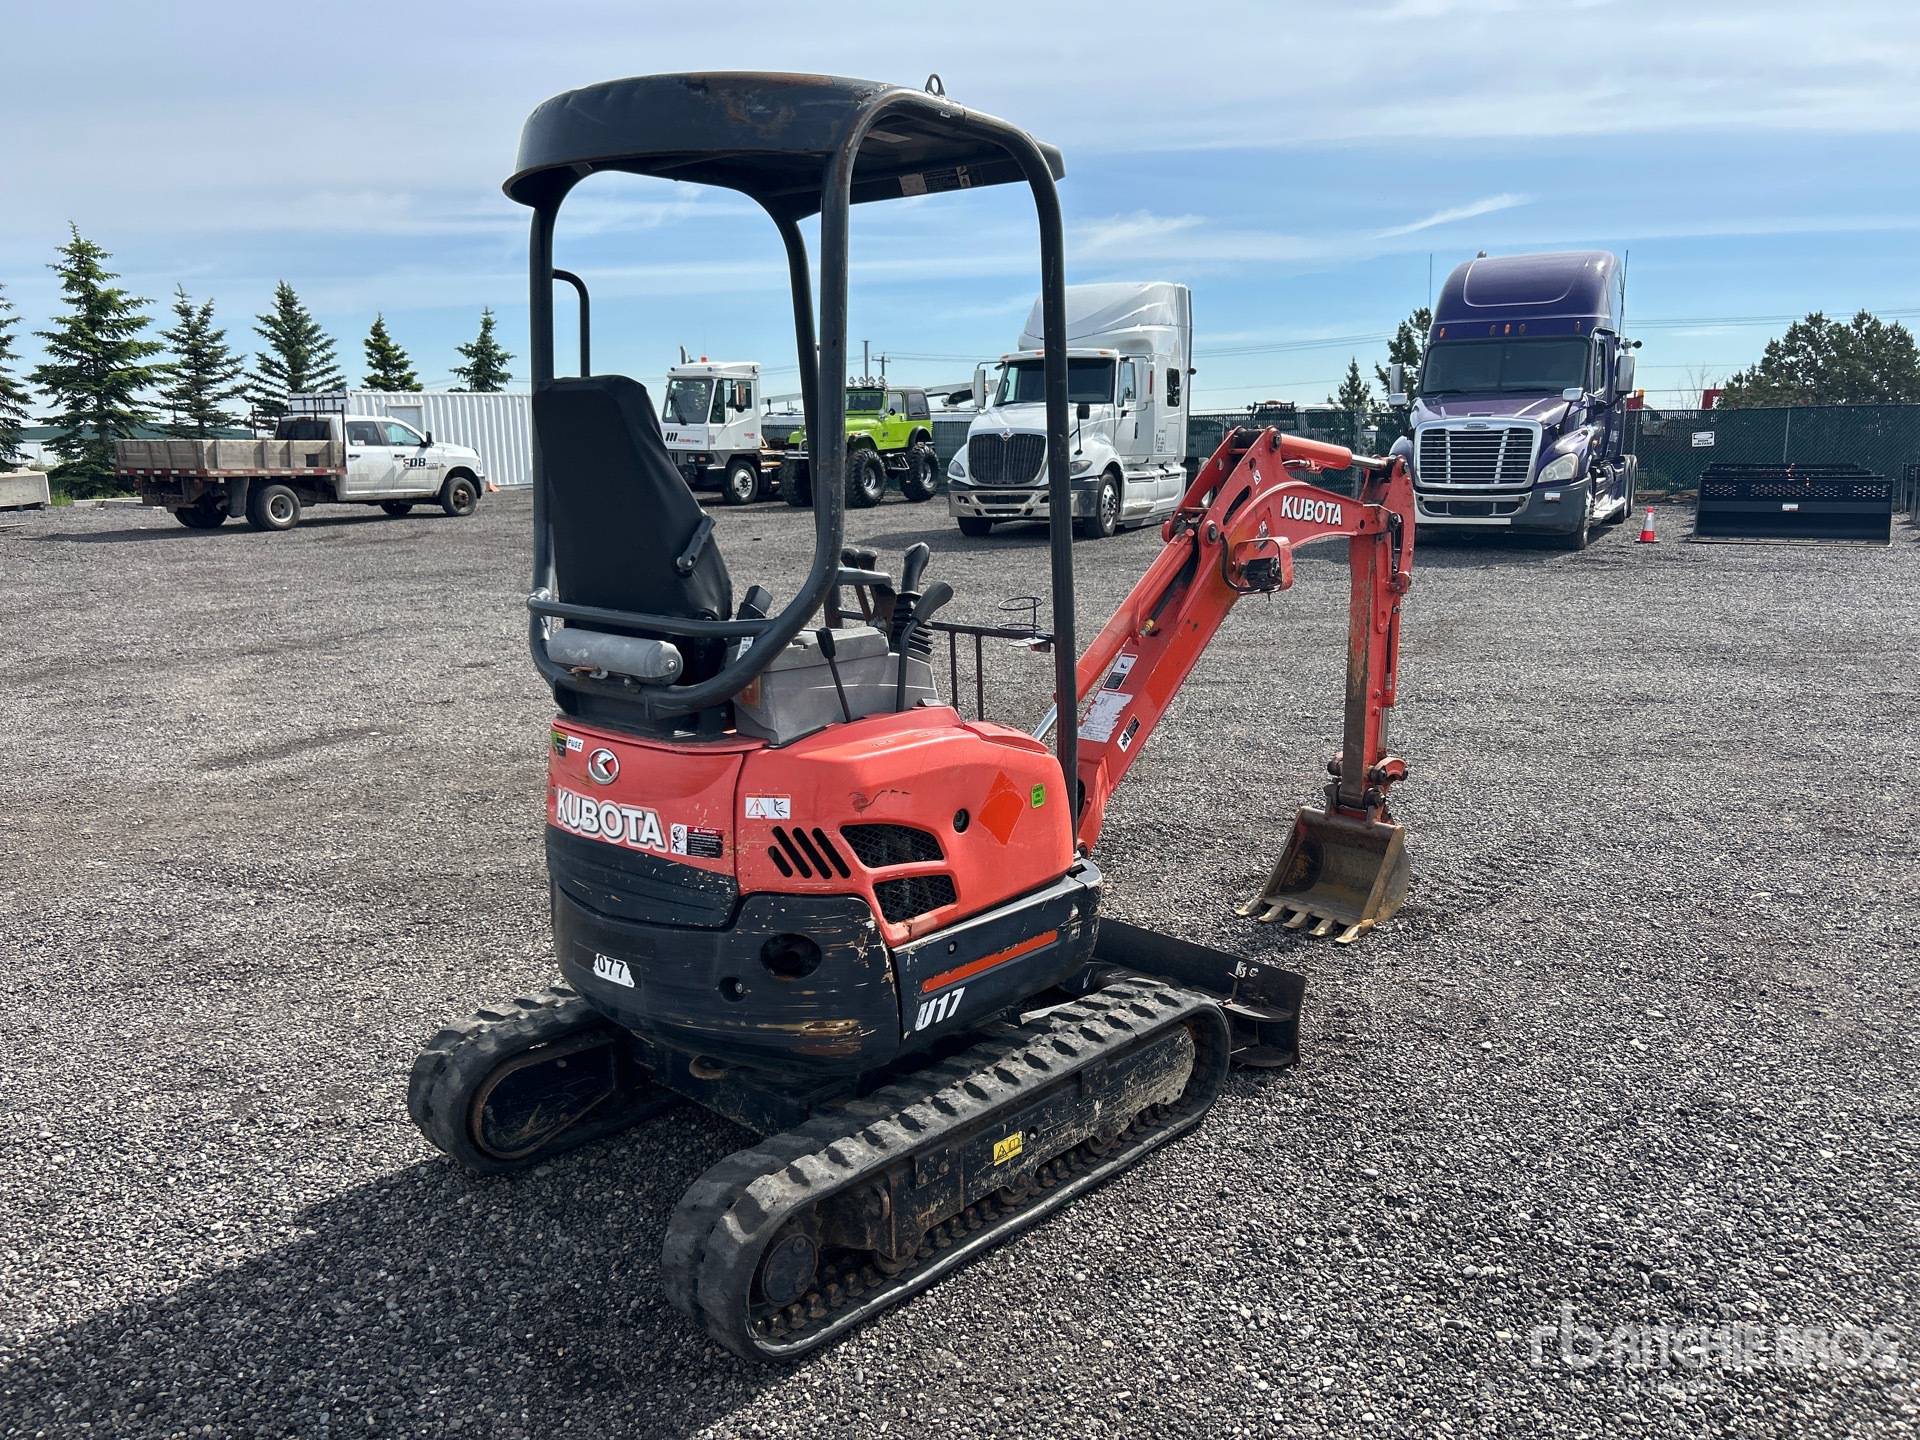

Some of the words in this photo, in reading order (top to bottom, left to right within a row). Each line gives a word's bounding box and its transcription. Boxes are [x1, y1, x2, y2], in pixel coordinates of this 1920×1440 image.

[1280, 494, 1342, 526] KUBOTA
[568, 739, 582, 750] FUSE
[557, 787, 666, 848] KUBOTA
[914, 986, 966, 1031] U17
